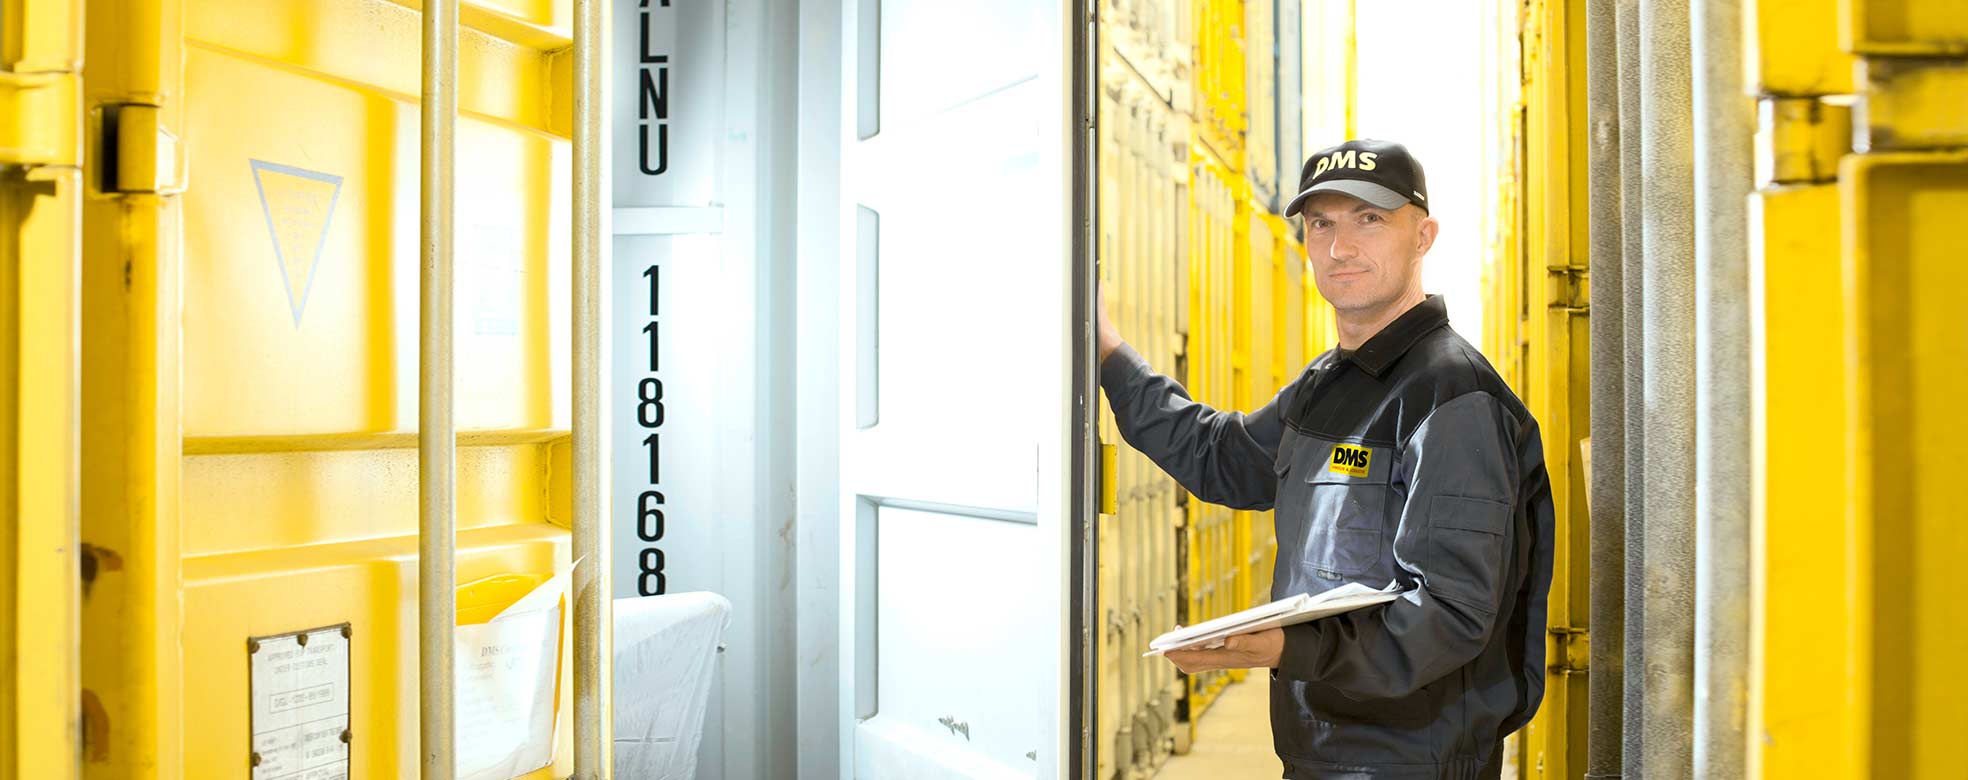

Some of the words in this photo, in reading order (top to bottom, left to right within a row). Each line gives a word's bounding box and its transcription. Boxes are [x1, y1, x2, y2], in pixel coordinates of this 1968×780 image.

[639, 0, 670, 176] LNU
[1312, 150, 1378, 180] DMS
[637, 265, 666, 597] 118168
[1333, 447, 1369, 468] DMS
